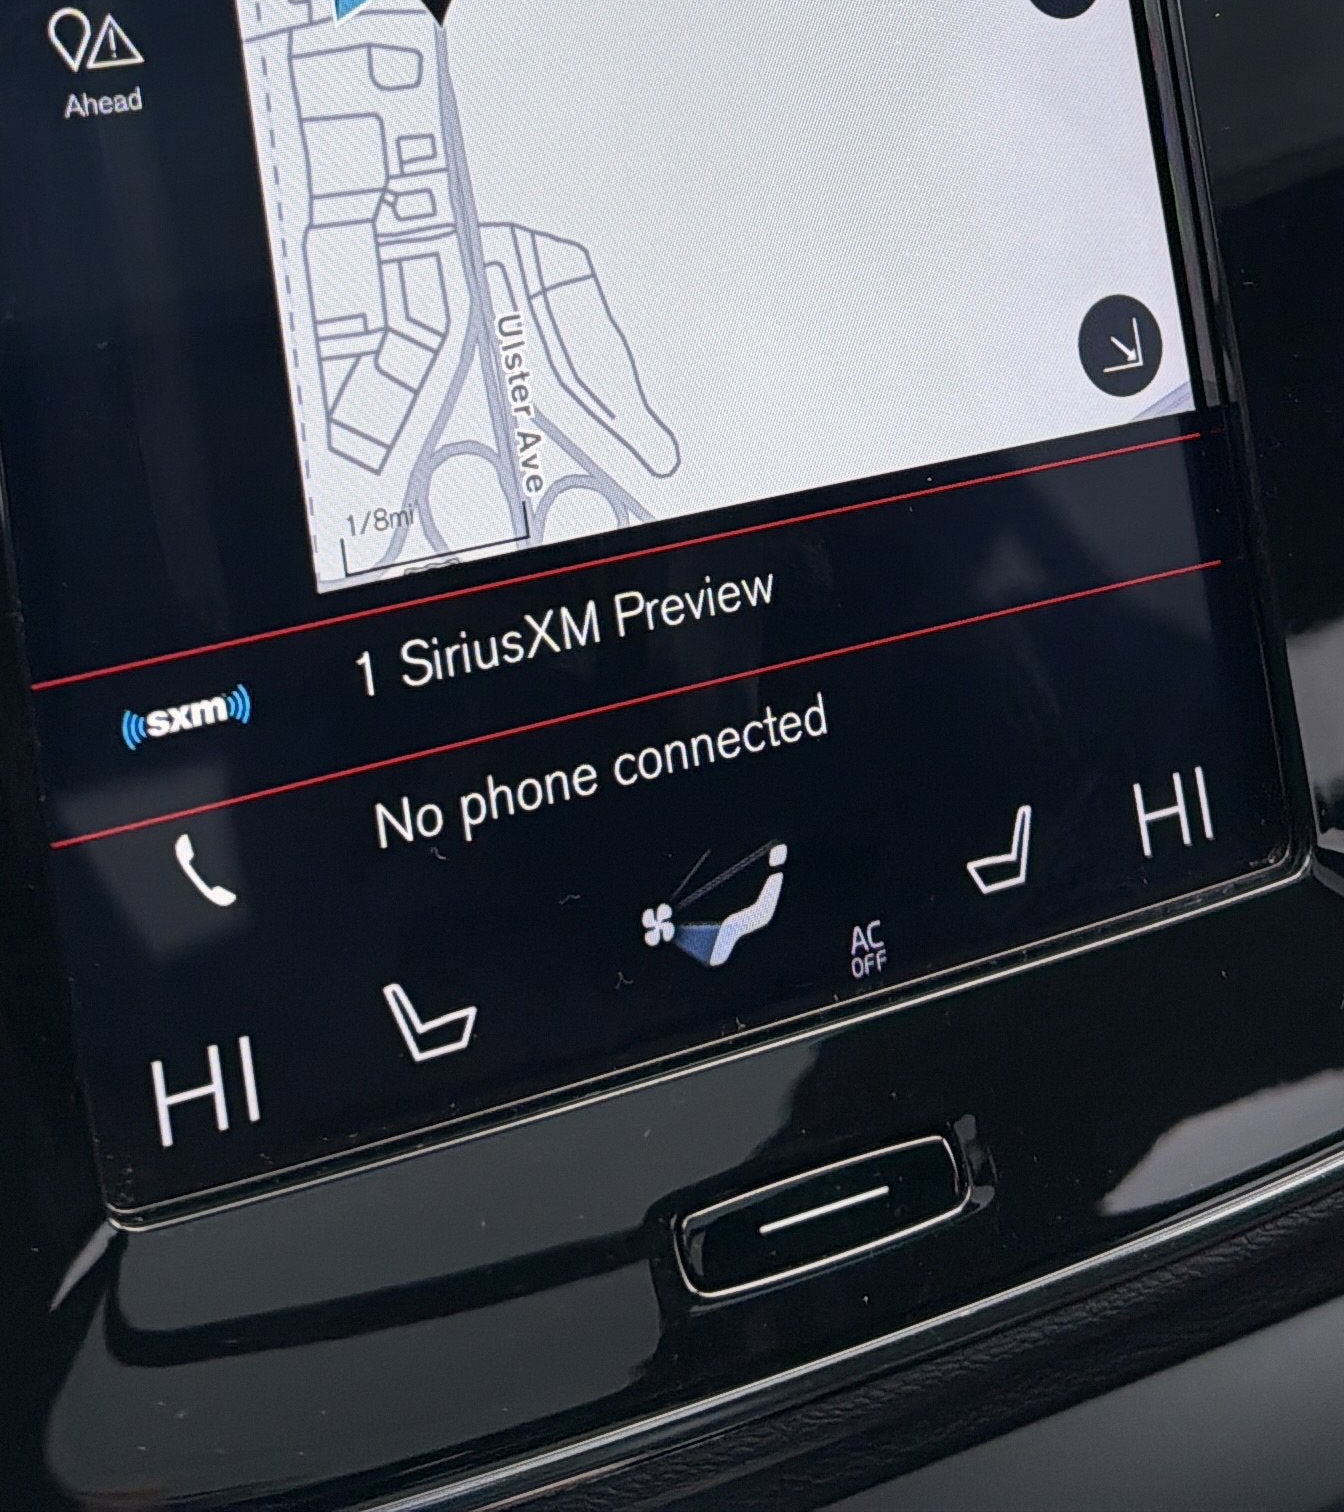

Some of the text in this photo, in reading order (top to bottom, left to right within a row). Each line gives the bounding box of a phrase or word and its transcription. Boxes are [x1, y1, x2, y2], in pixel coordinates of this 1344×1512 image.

[64, 86, 143, 120] Ahead
[498, 314, 544, 494] Ulster Ave
[356, 572, 774, 697] 1 SiriusXM Preview
[146, 695, 229, 738] sxm
[374, 691, 828, 849] No phone connected
[1132, 765, 1215, 858] HI
[851, 919, 885, 956] AC
[851, 948, 888, 979] OFF
[150, 1034, 261, 1148] HI
